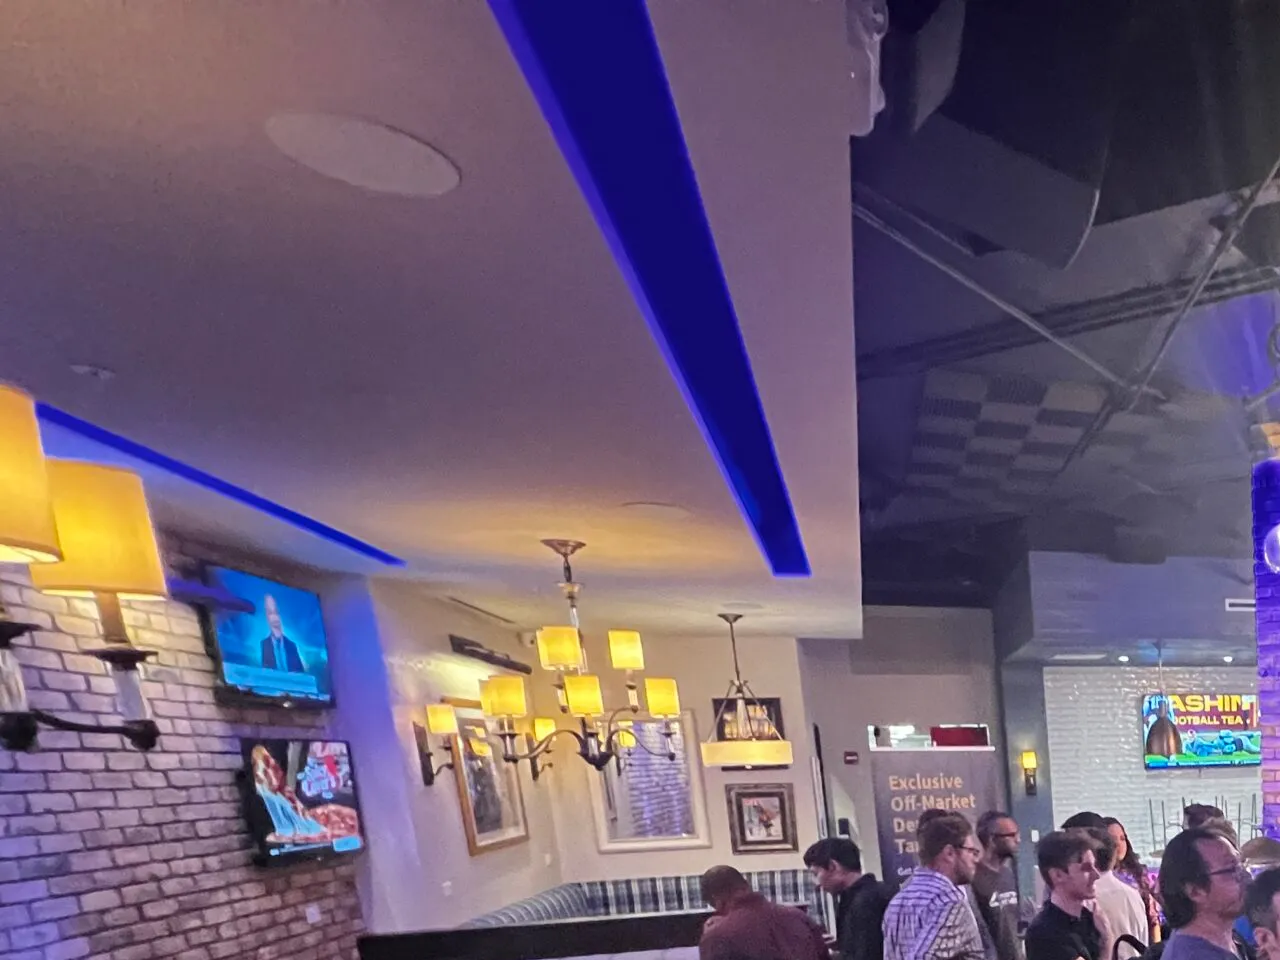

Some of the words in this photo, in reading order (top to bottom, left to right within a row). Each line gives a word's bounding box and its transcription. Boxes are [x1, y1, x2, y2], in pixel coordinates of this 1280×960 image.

[1173, 714, 1220, 726] OOTBALL
[1220, 714, 1244, 725] TEA
[888, 773, 963, 791] Exclusive
[890, 794, 977, 811] Off-Market
